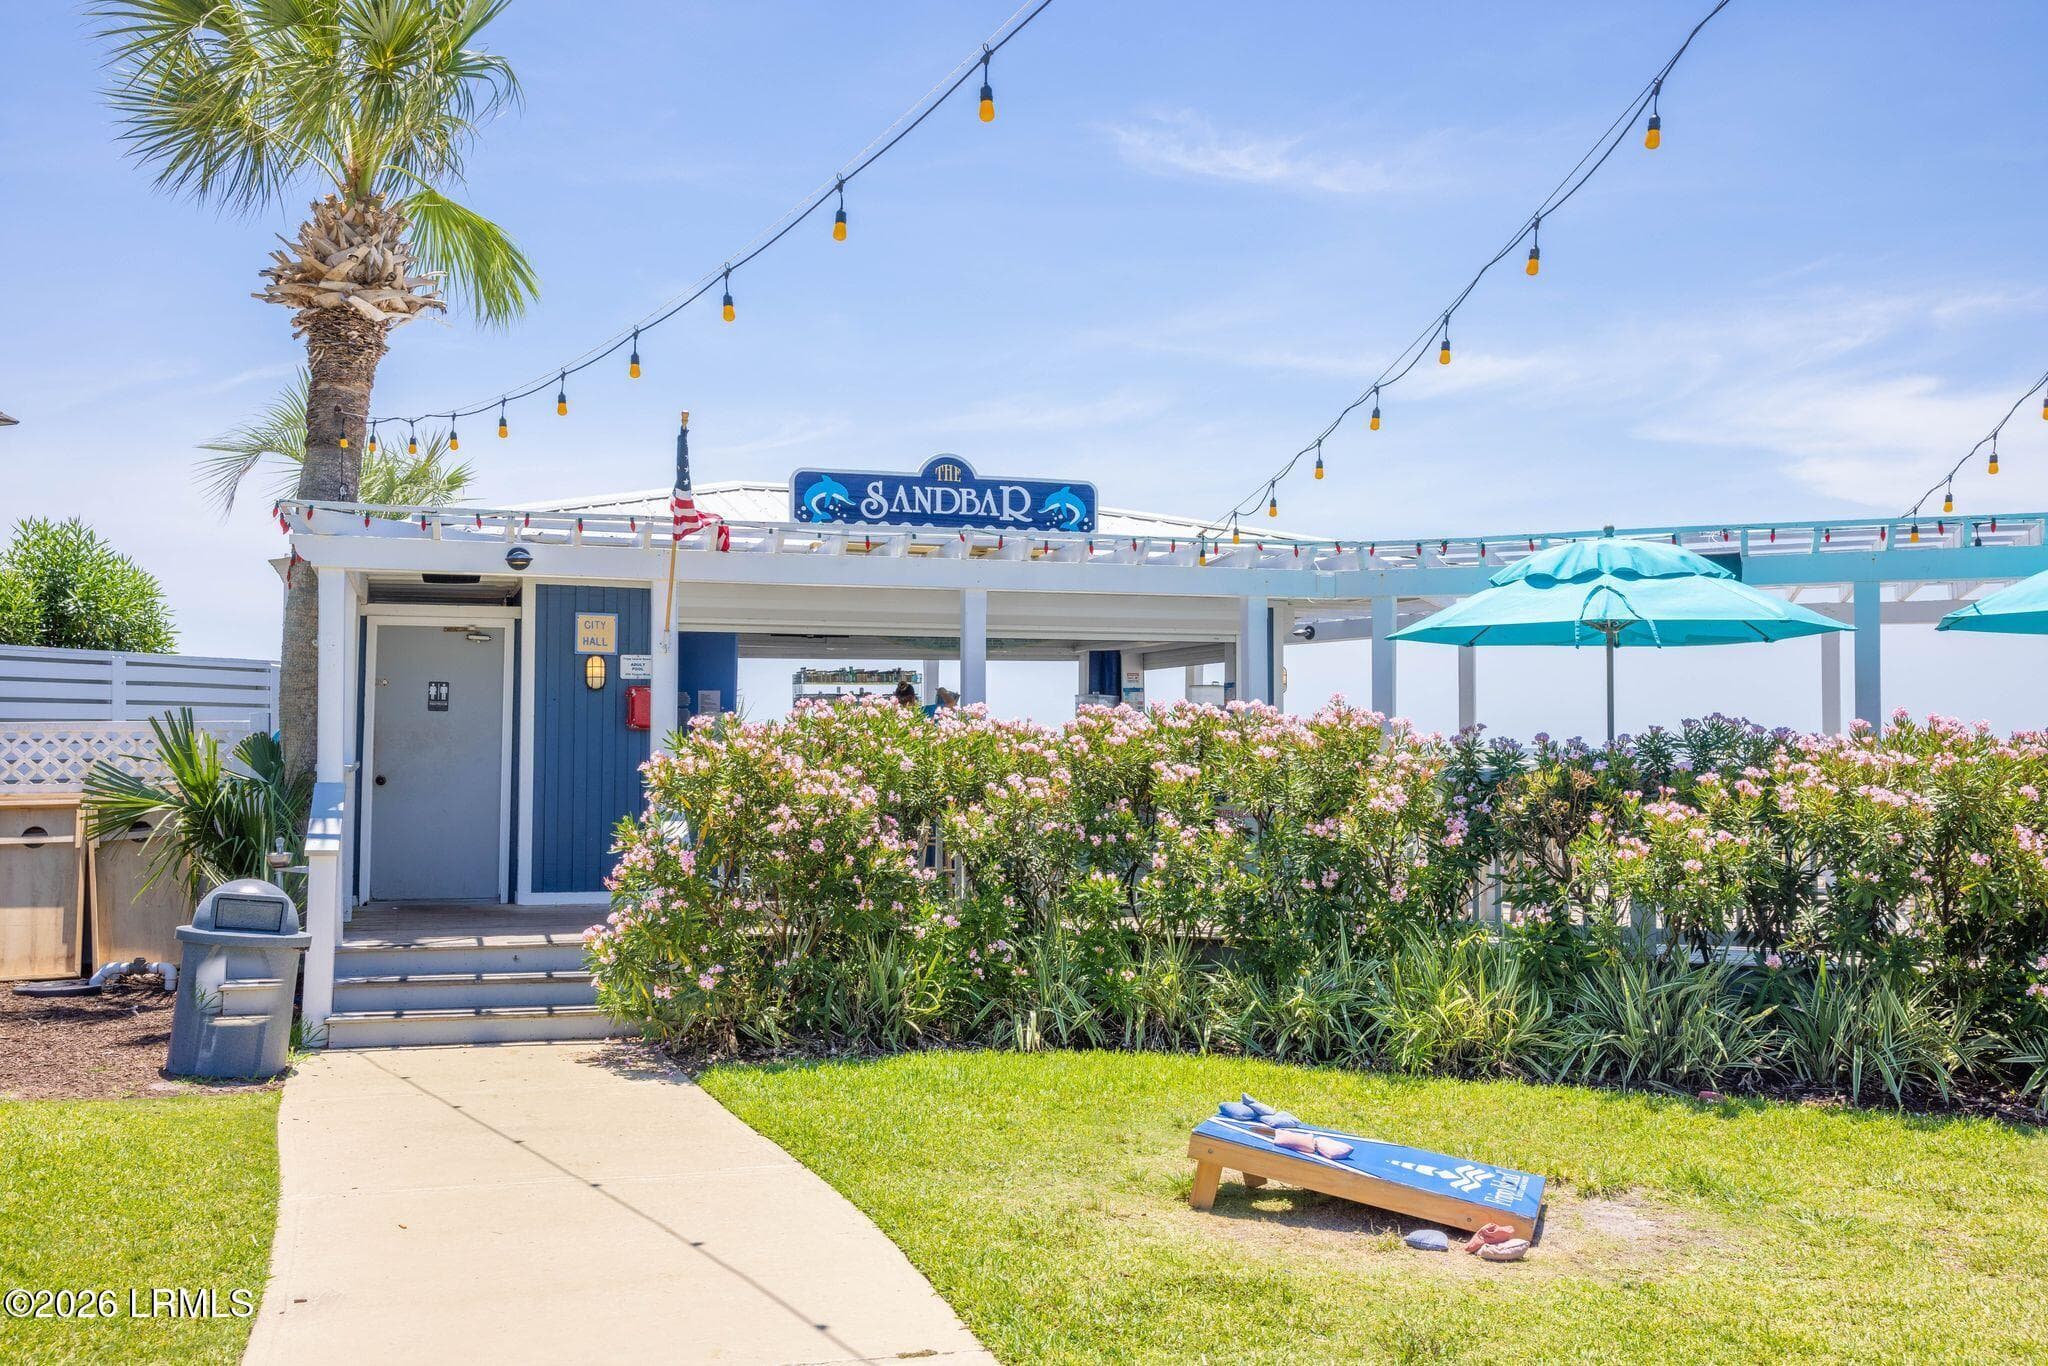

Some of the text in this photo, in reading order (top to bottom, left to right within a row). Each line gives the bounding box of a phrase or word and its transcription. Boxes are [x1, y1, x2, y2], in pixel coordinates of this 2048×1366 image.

[935, 464, 961, 482] THE
[860, 480, 1032, 522] SANDBAR
[584, 620, 606, 630] CITY
[582, 637, 608, 647] HALL
